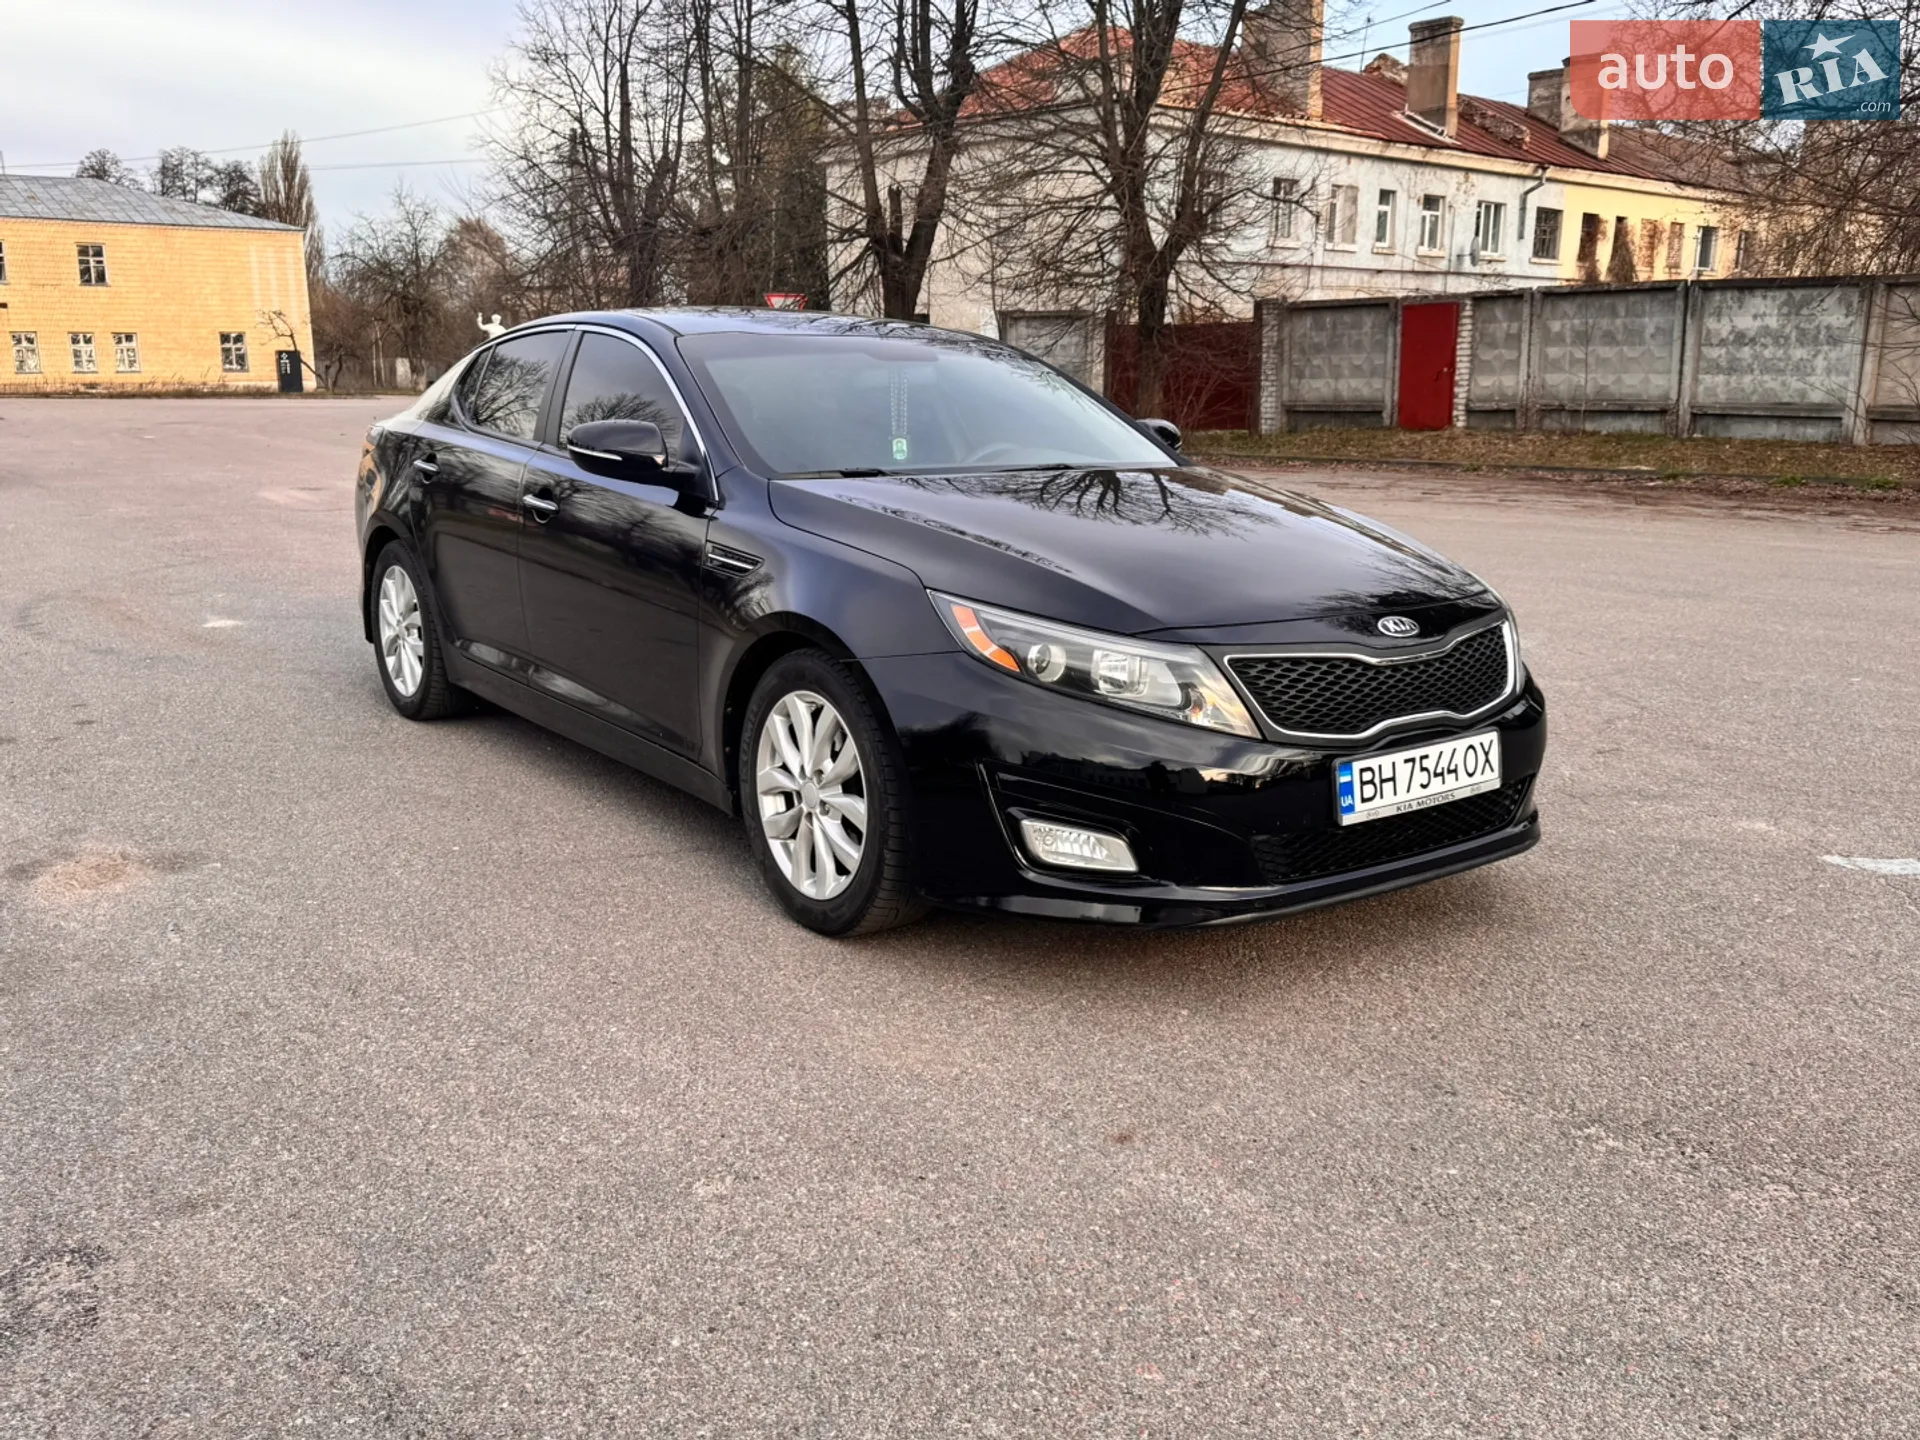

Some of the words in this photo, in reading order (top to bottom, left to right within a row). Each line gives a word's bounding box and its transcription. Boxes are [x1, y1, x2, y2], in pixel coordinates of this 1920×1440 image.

[1359, 761, 1398, 804] BH
[1404, 748, 1459, 794] 7544
[1463, 739, 1494, 778] OX
[1341, 795, 1354, 807] UA
[1396, 803, 1414, 813] KIA
[1416, 793, 1456, 808] MOTORS
